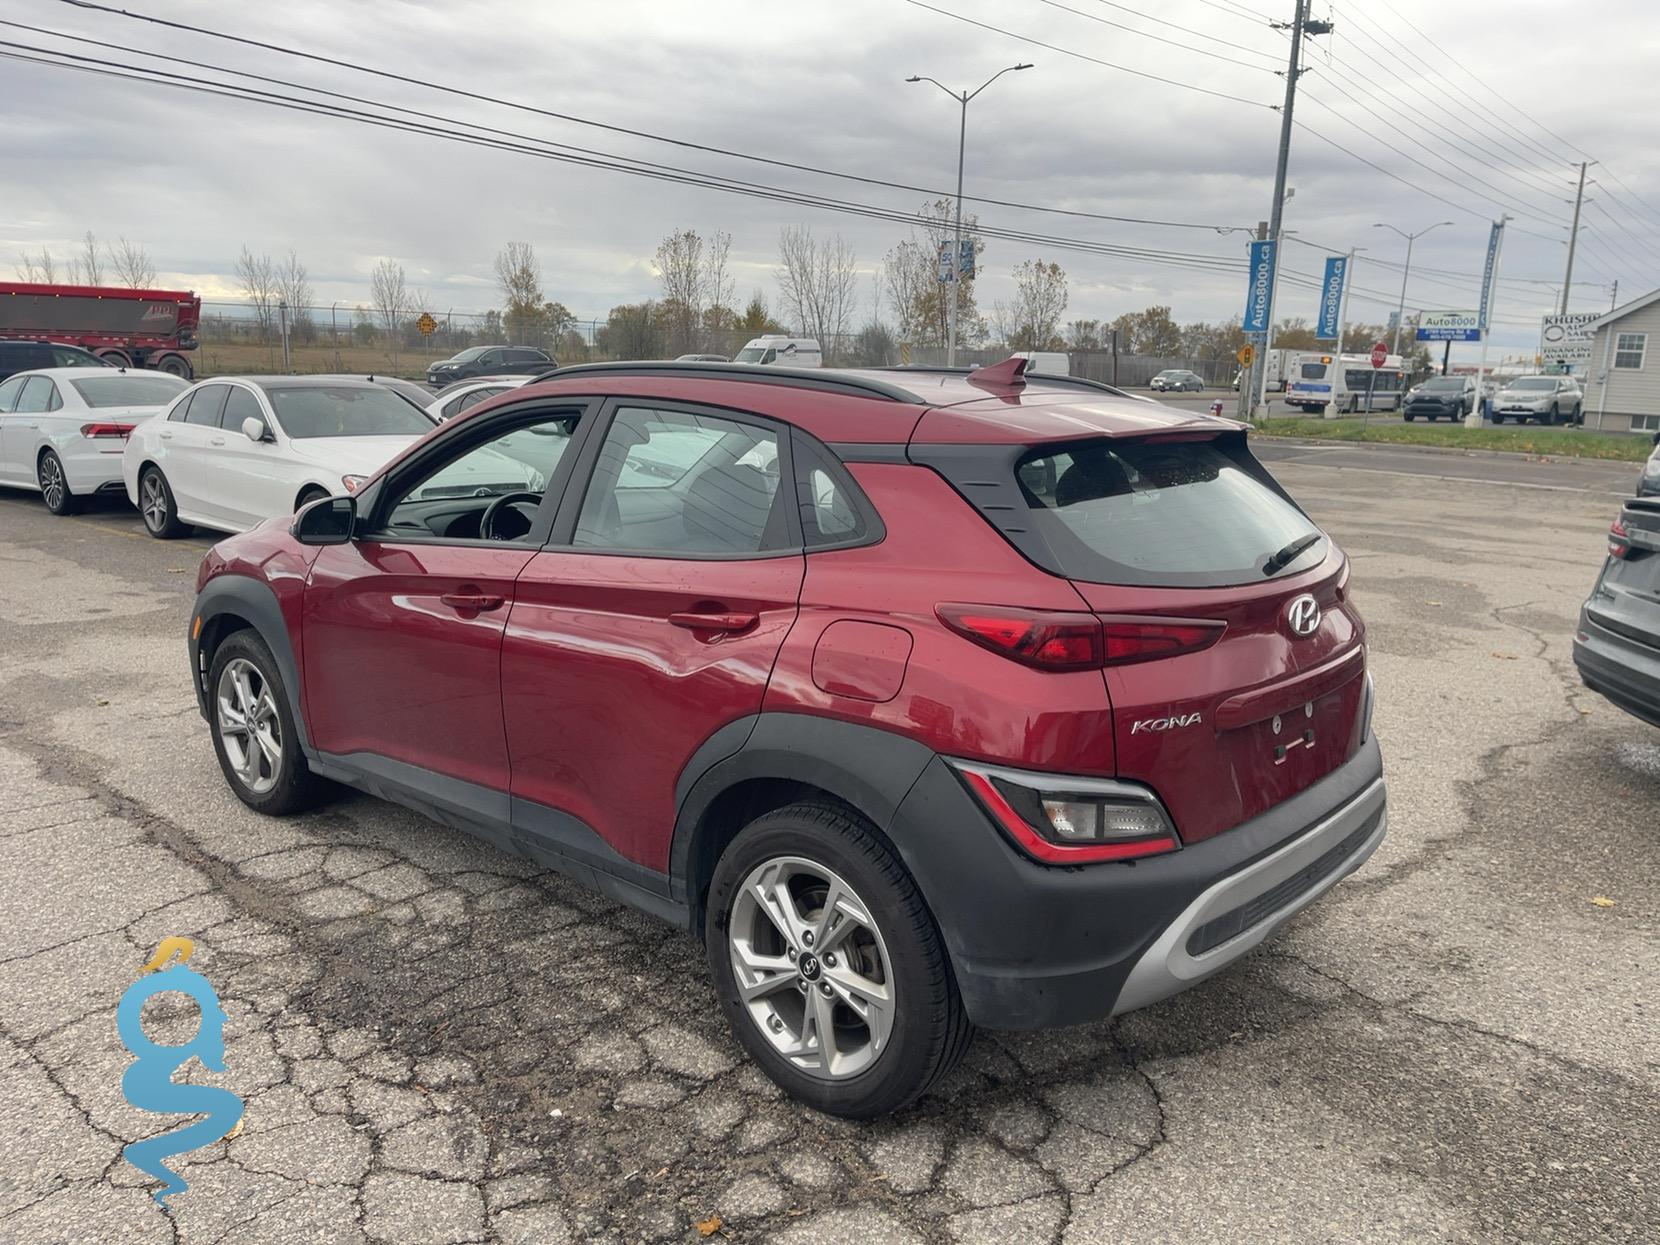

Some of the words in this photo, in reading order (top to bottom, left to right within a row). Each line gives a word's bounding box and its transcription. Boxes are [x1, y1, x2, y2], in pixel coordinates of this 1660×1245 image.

[1252, 244, 1271, 328] Auto8000.ca
[1324, 260, 1343, 335] Auto8000.ca
[1426, 316, 1476, 326] Auto8000
[1131, 712, 1202, 735] KONA
